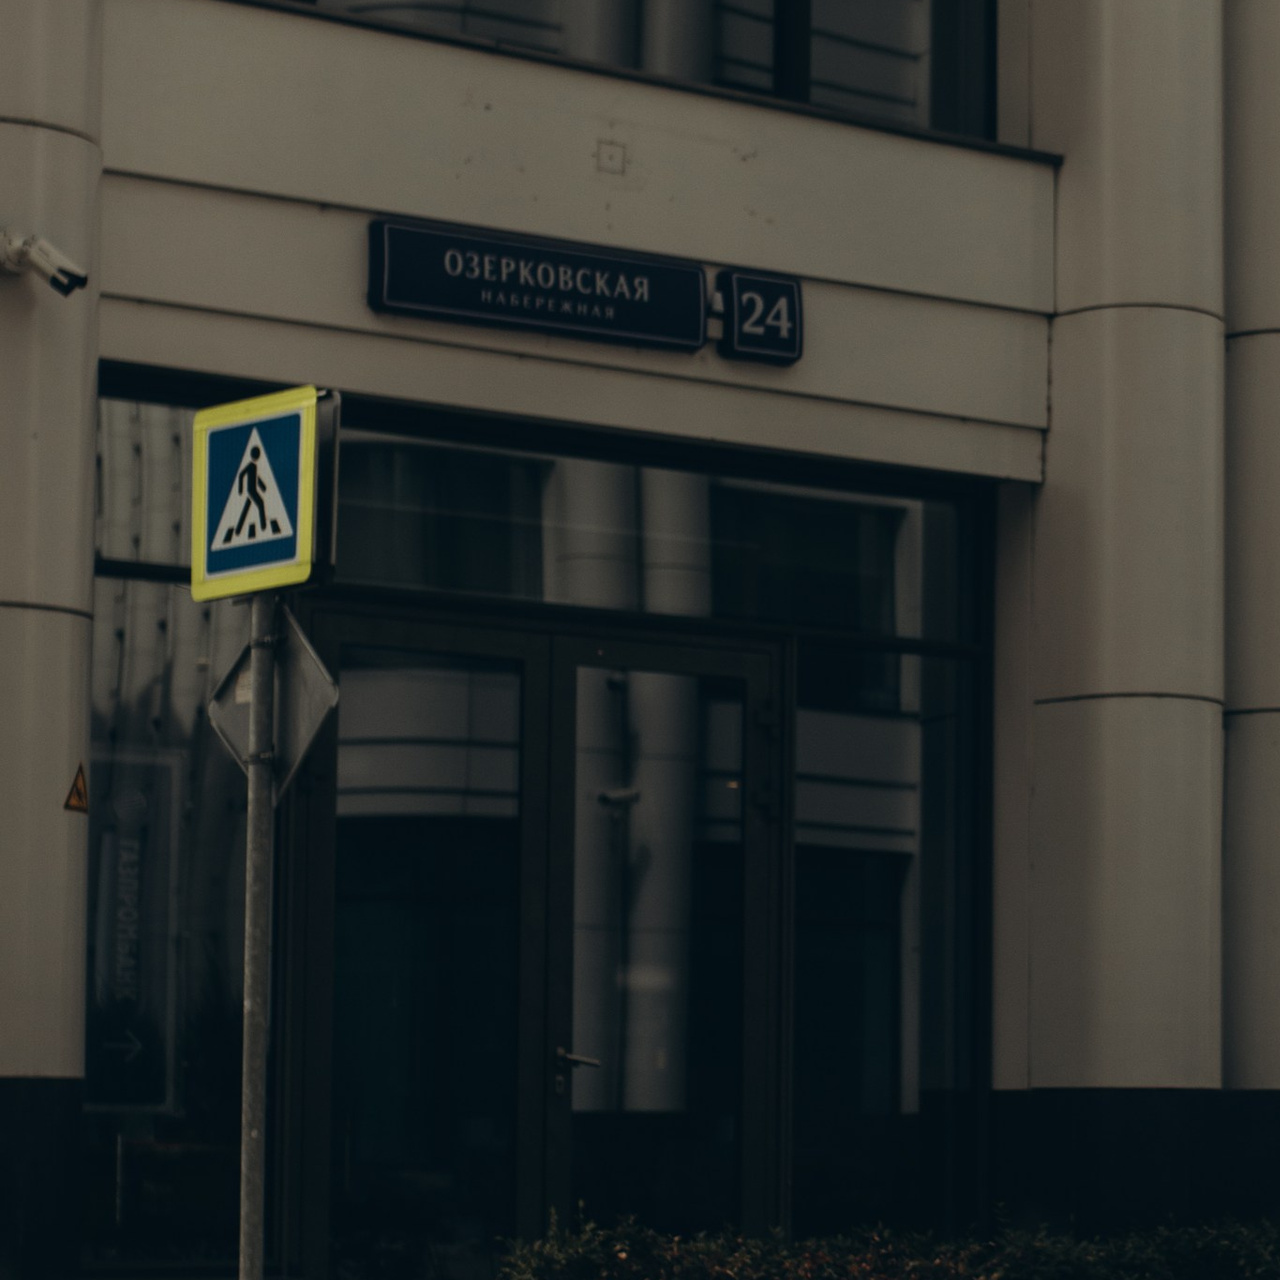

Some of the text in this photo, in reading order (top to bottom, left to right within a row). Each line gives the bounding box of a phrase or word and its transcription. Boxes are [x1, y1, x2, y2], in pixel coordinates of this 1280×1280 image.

[443, 248, 650, 303] ОЗЕРКОВСКАЯ
[481, 290, 616, 320] НАБЕРЕЖНАЯ
[740, 291, 793, 339] 24
[115, 837, 140, 1002] ГАЗПРОМБАНК
